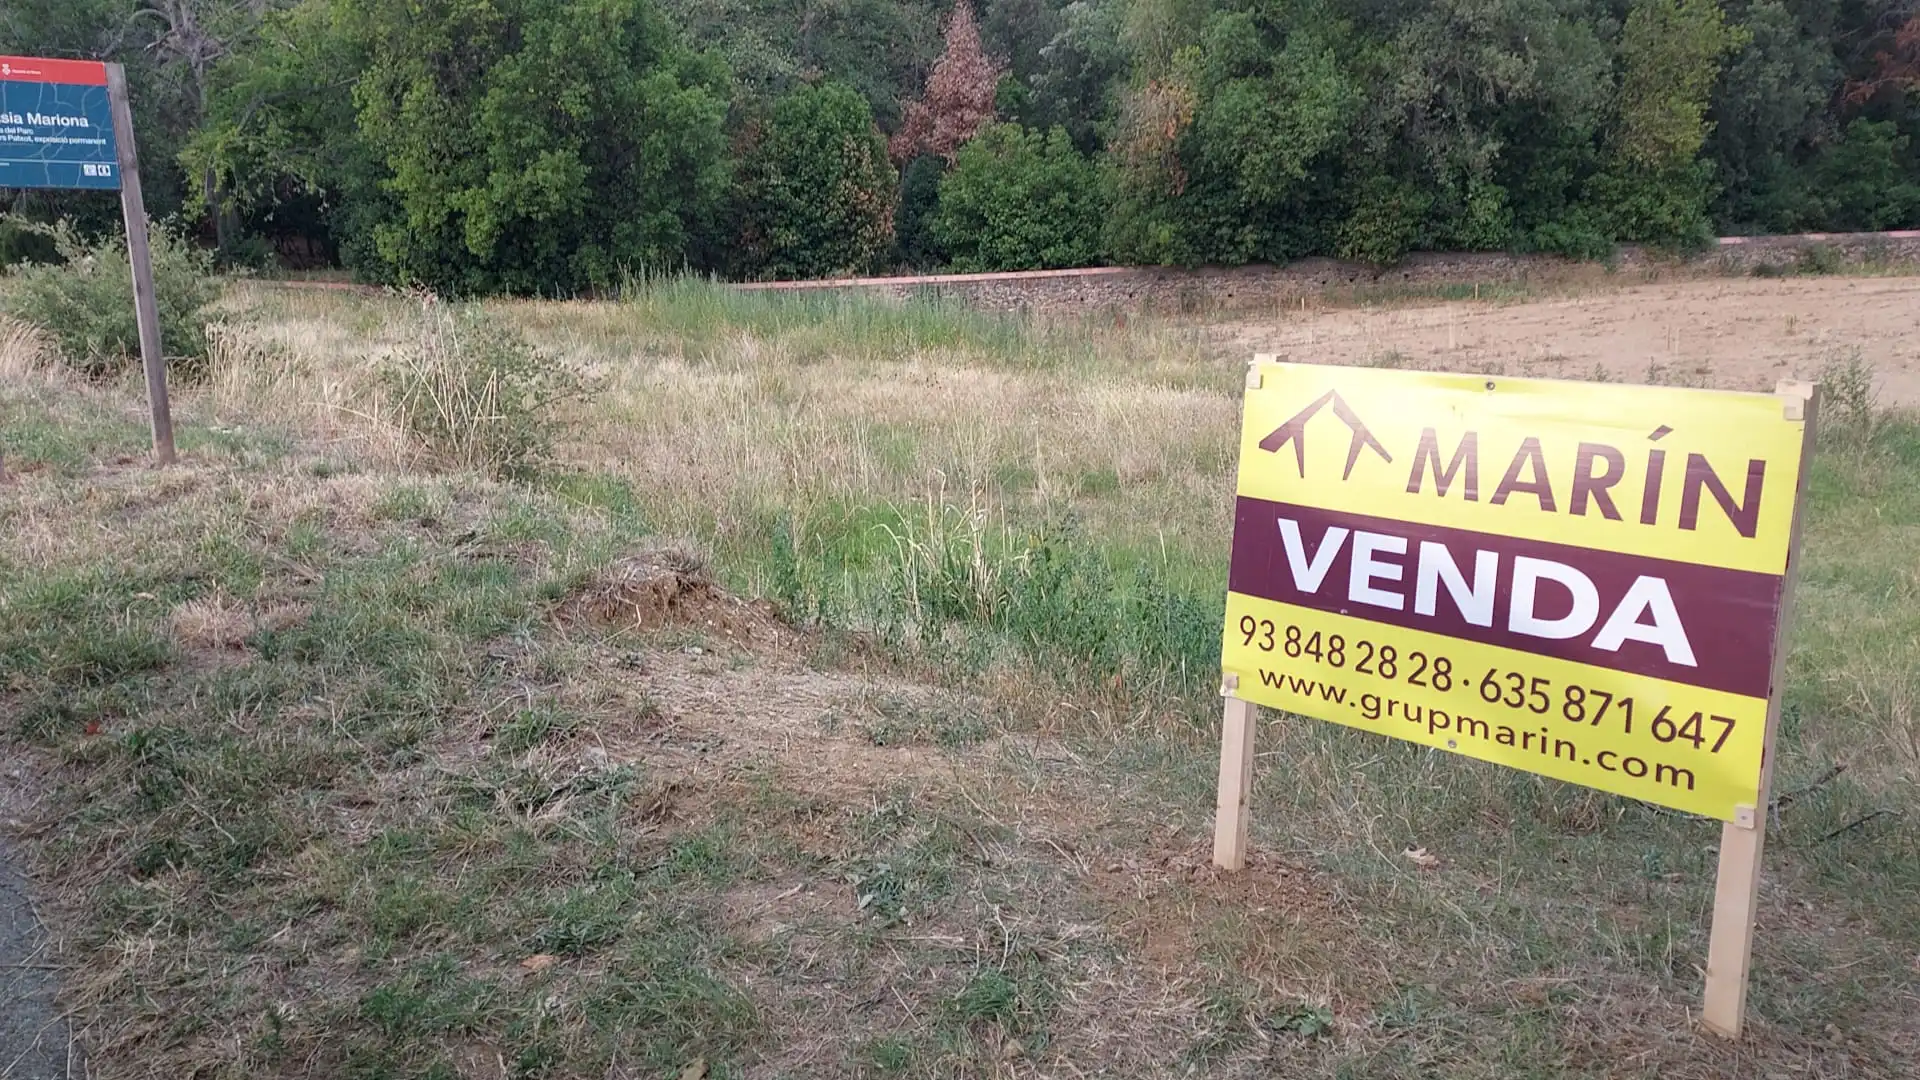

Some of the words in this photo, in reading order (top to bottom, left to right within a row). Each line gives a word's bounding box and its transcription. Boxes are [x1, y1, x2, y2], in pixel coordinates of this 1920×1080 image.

[0, 111, 23, 124] sia
[27, 112, 88, 128] Mariona
[5, 126, 16, 134] del
[17, 127, 34, 135] Parc
[1406, 425, 1766, 538] MARÍN
[1277, 518, 1698, 668] VENDA
[1239, 616, 1275, 652] 93
[1284, 626, 1346, 667] 848
[1356, 641, 1398, 680] 28
[1408, 657, 1453, 692] 28
[1480, 668, 1550, 714] 635
[1564, 690, 1633, 734] 871
[1651, 706, 1735, 752] 647
[1259, 669, 1695, 790] www.grupmarin.com
